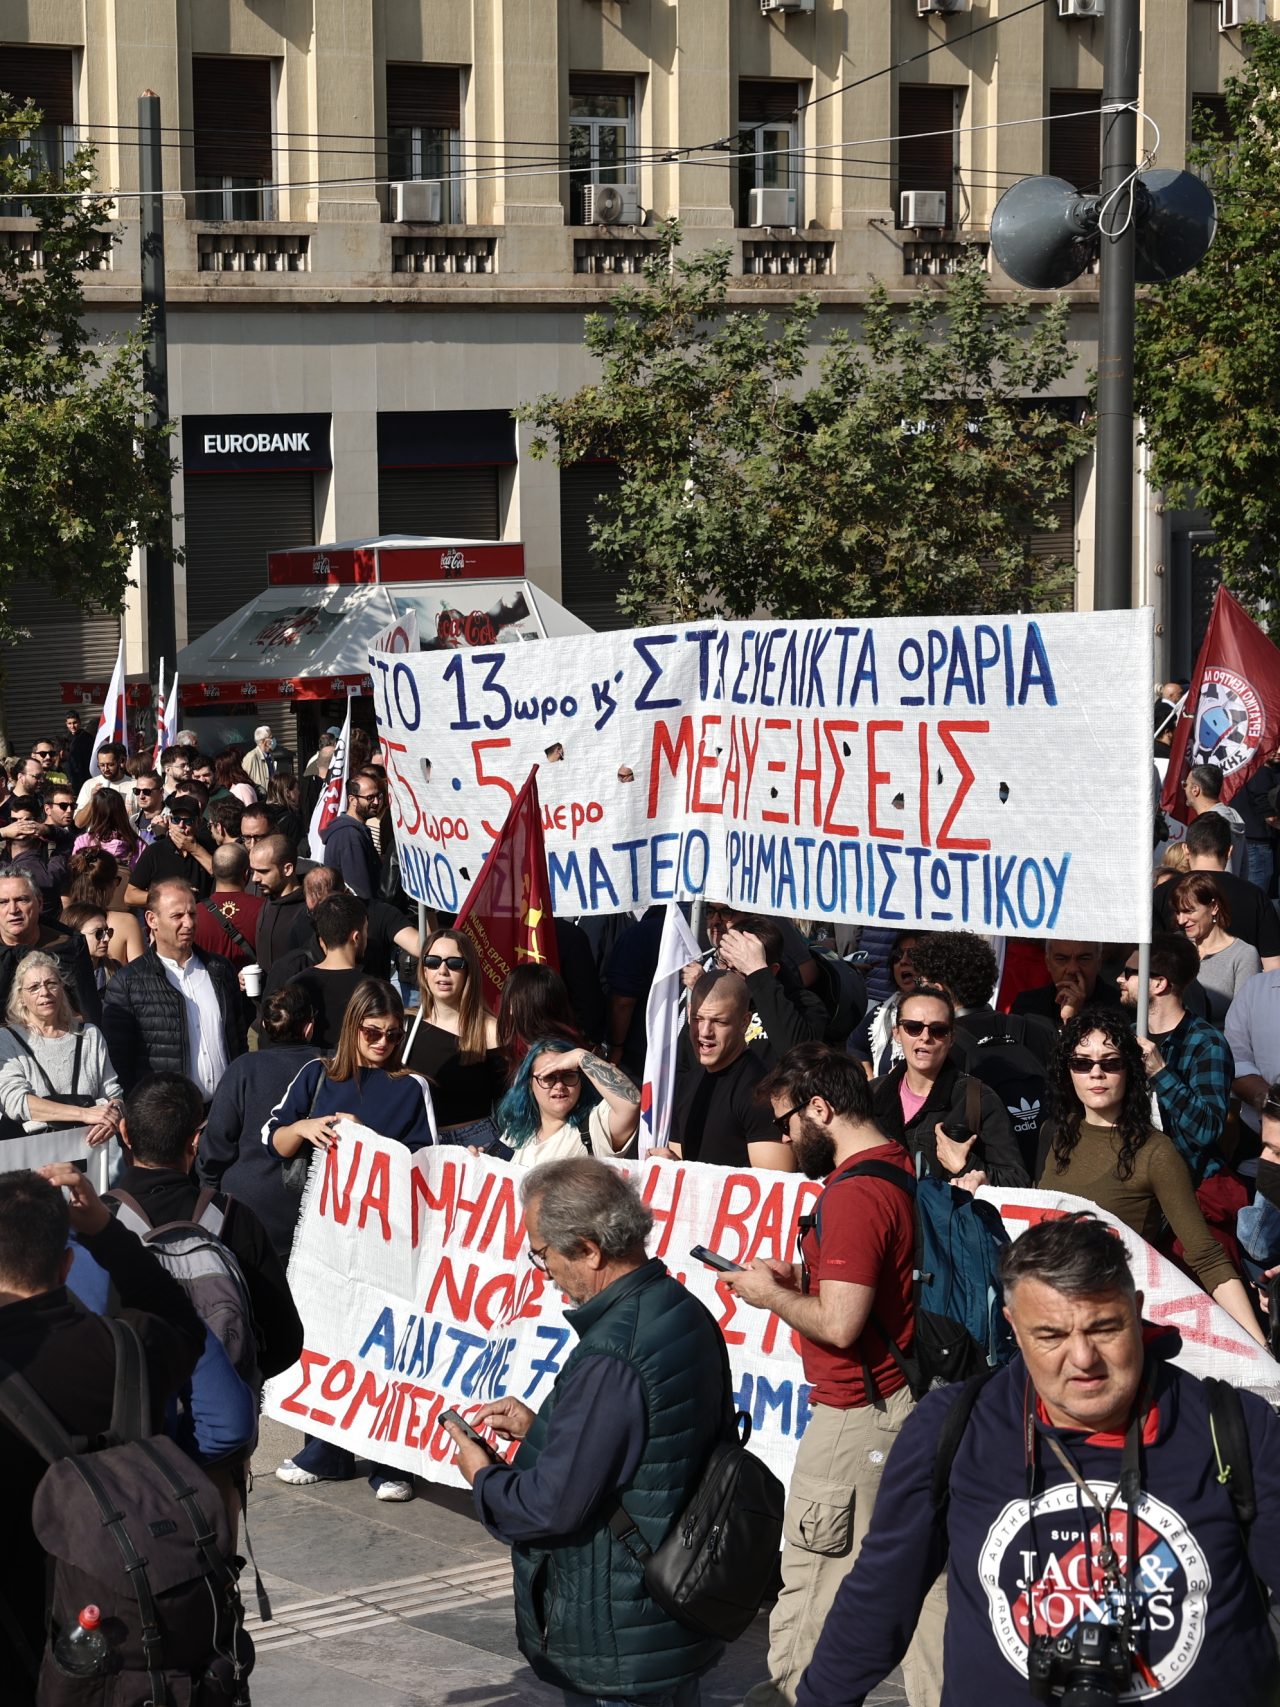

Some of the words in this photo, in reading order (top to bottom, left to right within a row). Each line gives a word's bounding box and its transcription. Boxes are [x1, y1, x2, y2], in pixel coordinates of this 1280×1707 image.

[204, 432, 310, 454] EUROBANK
[898, 621, 1059, 707] ΩΡΑΡΙΑ
[726, 830, 1072, 929] ΡΗΜΑΤΟΠΙΣΤΩΤΙΚΟΥ
[319, 1138, 392, 1241] ΝΑ
[705, 1173, 825, 1268] ΒΑΡ
[1020, 1591, 1175, 1631] JONS
